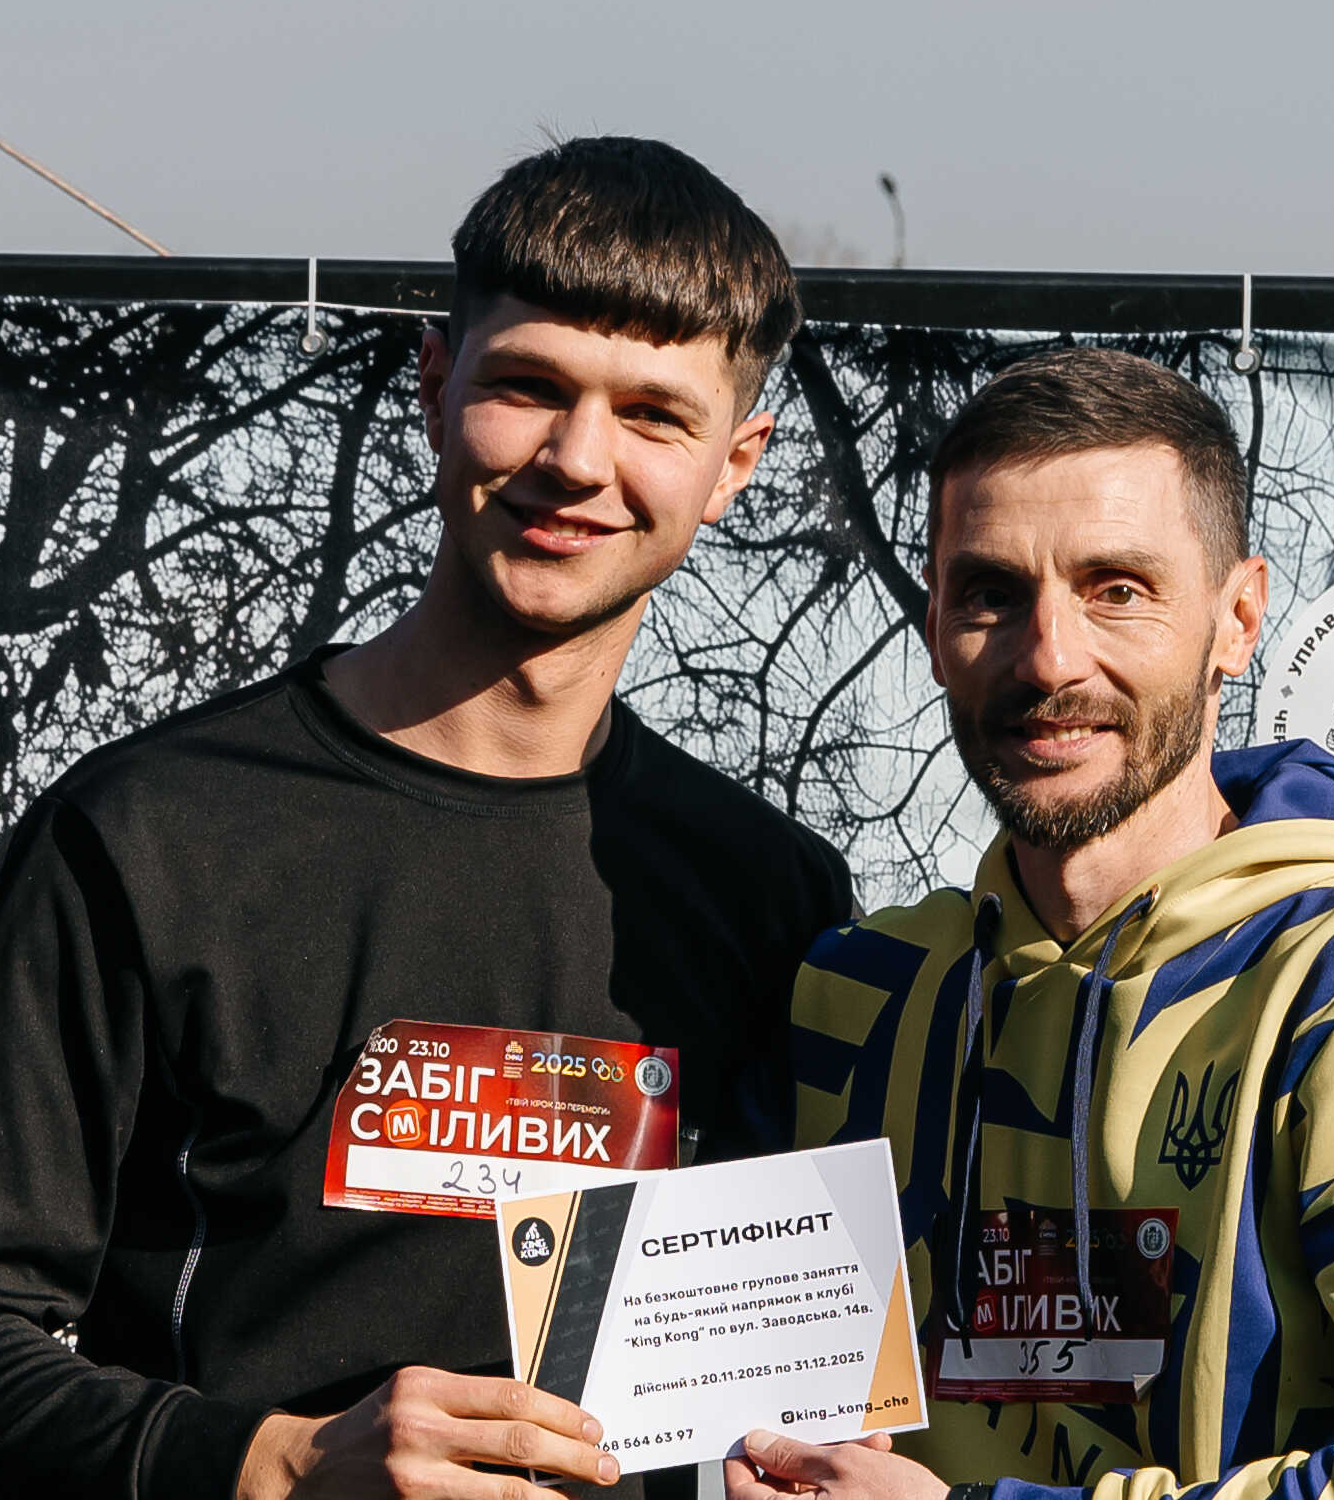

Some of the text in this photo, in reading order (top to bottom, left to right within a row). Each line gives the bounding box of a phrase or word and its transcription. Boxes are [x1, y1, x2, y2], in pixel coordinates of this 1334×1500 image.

[408, 1039, 450, 1059] 23.10
[531, 1051, 587, 1078] 2025
[355, 1057, 496, 1104] ЗАБІГ
[442, 1160, 522, 1195] 234
[641, 1211, 834, 1257] СЕРТИФІКАТ
[982, 1228, 1010, 1243] 23.10
[624, 1263, 859, 1307] На безкоштовне групове заняття
[634, 1282, 854, 1327] на будь-який напрямок в клубі
[709, 1325, 726, 1336] по
[729, 1321, 759, 1335] вул.
[761, 1309, 842, 1329] Заводська,
[844, 1303, 873, 1316] 14в.
[633, 1350, 865, 1397] Дійсний з 20.11.2025 по 31.12.2025
[597, 1428, 694, 1453] 68 564 63 97
